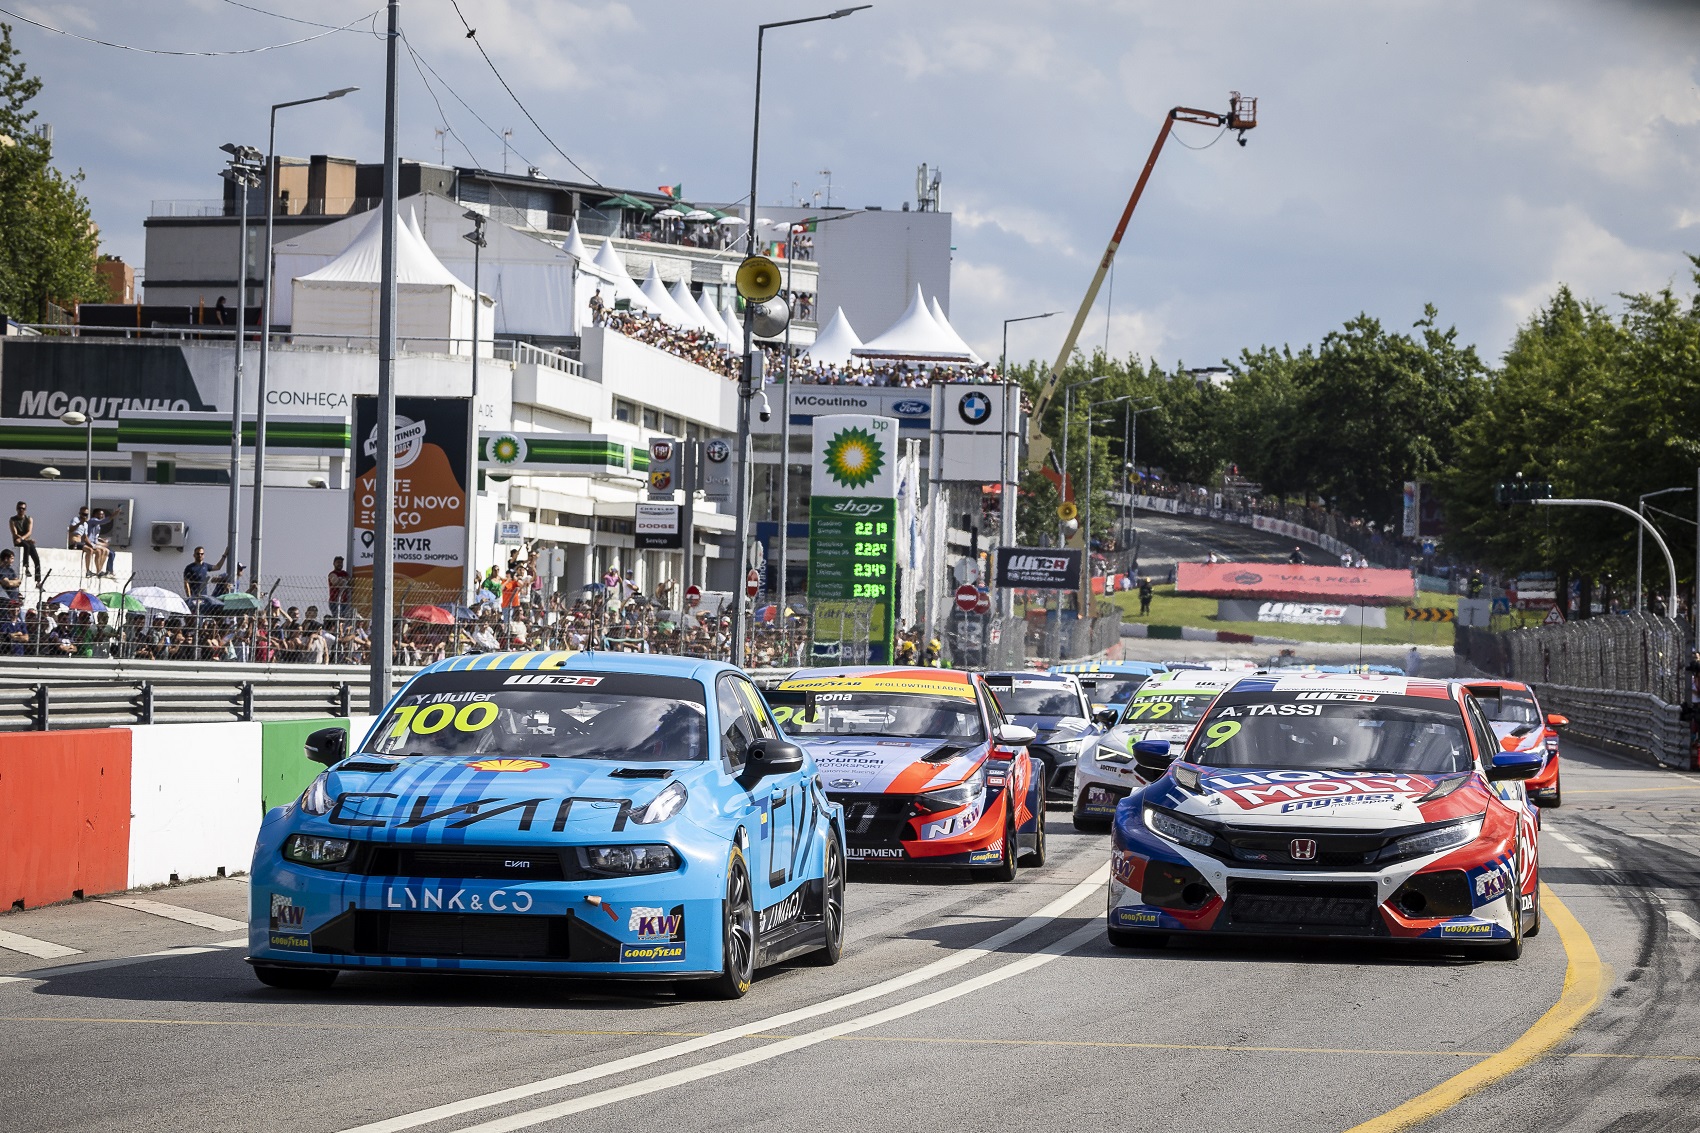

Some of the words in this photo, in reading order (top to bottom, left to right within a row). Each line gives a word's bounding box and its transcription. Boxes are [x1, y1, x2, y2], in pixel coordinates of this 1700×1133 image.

[266, 391, 348, 409] CONHEÇA
[794, 395, 868, 408] MCoutinho
[872, 418, 889, 432] bp
[369, 426, 421, 450] MTINHO
[363, 478, 411, 492] VITE
[362, 495, 374, 508] O
[394, 496, 408, 509] EU
[413, 496, 460, 509] NOVO
[833, 500, 883, 516] shop
[393, 537, 431, 551] RVIR
[503, 674, 605, 687] WTCR
[787, 680, 862, 689] GOODYEAR
[875, 682, 965, 692] #FOLLOWTHELEADER
[416, 692, 496, 705] Y.Muller
[1134, 695, 1196, 704] R.HUFF
[1295, 692, 1380, 703] WTCR
[1129, 702, 1173, 720] 79
[390, 701, 499, 738] 100
[1206, 720, 1242, 749] 9
[1100, 764, 1117, 773] LOCTITE
[1235, 778, 1413, 805] MOLY
[1281, 793, 1395, 813] Engstler
[1330, 798, 1395, 808] motorsport
[972, 852, 1000, 861] GOODYEAR
[277, 905, 305, 924] KW
[1120, 913, 1156, 922] GOODYEAR
[638, 915, 682, 936] KW
[1444, 925, 1490, 934] GOODYEAR
[271, 936, 309, 947] GOODYEAR
[624, 947, 682, 959] GOODYEAR
